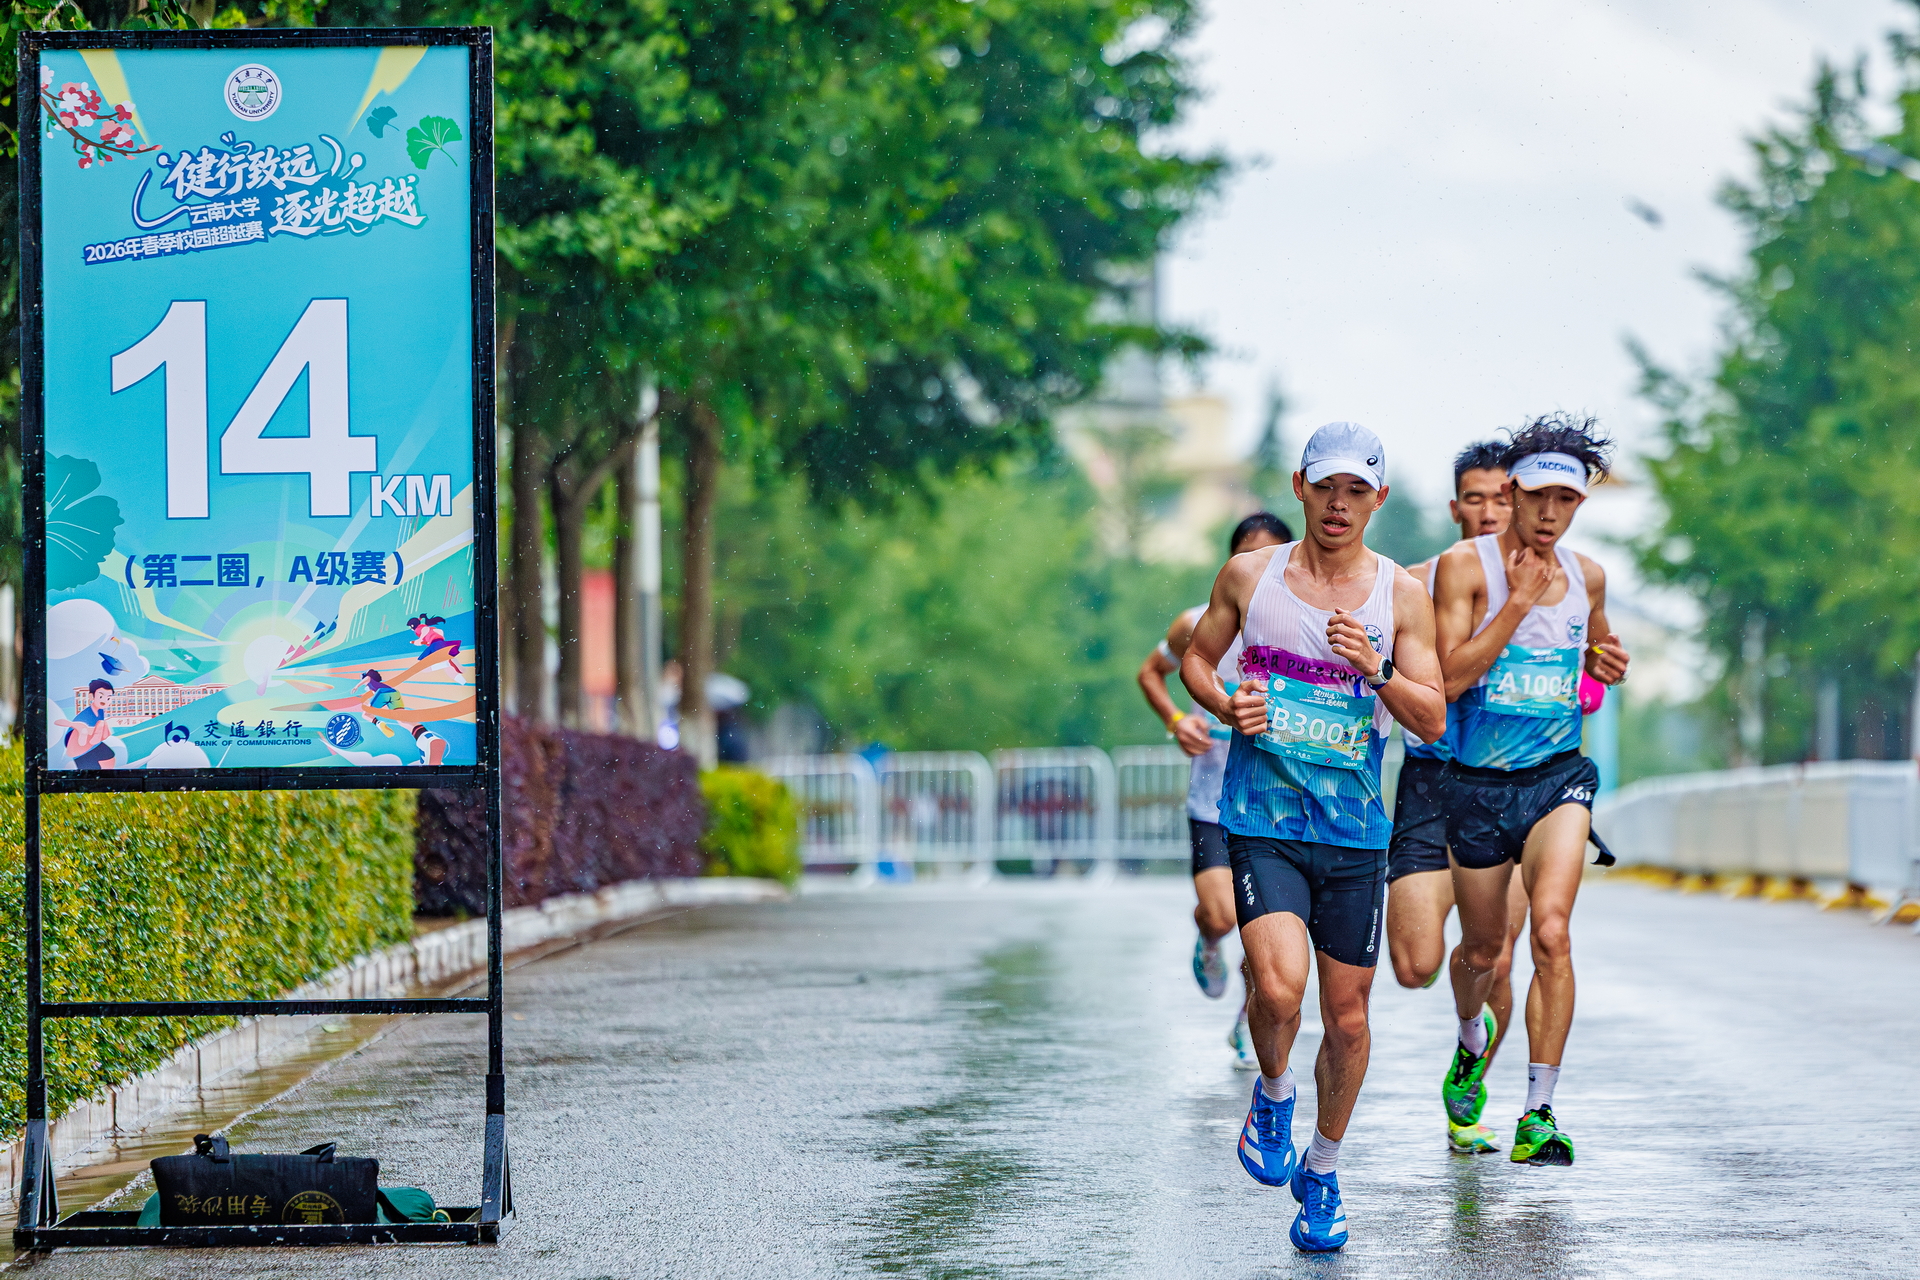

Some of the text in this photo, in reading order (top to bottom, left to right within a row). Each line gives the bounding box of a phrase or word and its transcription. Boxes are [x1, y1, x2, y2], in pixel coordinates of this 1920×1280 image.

[163, 144, 329, 199] 健行致远
[190, 197, 260, 224] 云南大学
[269, 175, 426, 236] 逐光超越
[84, 220, 265, 262] 2026年春季校园超越赛
[110, 297, 453, 520] 14 KM
[203, 719, 303, 738] 交通銀行
[236, 738, 312, 746] COMMUNICATIONS
[1271, 706, 1359, 747] B3001
[174, 1194, 272, 1216] 专用沙袋
